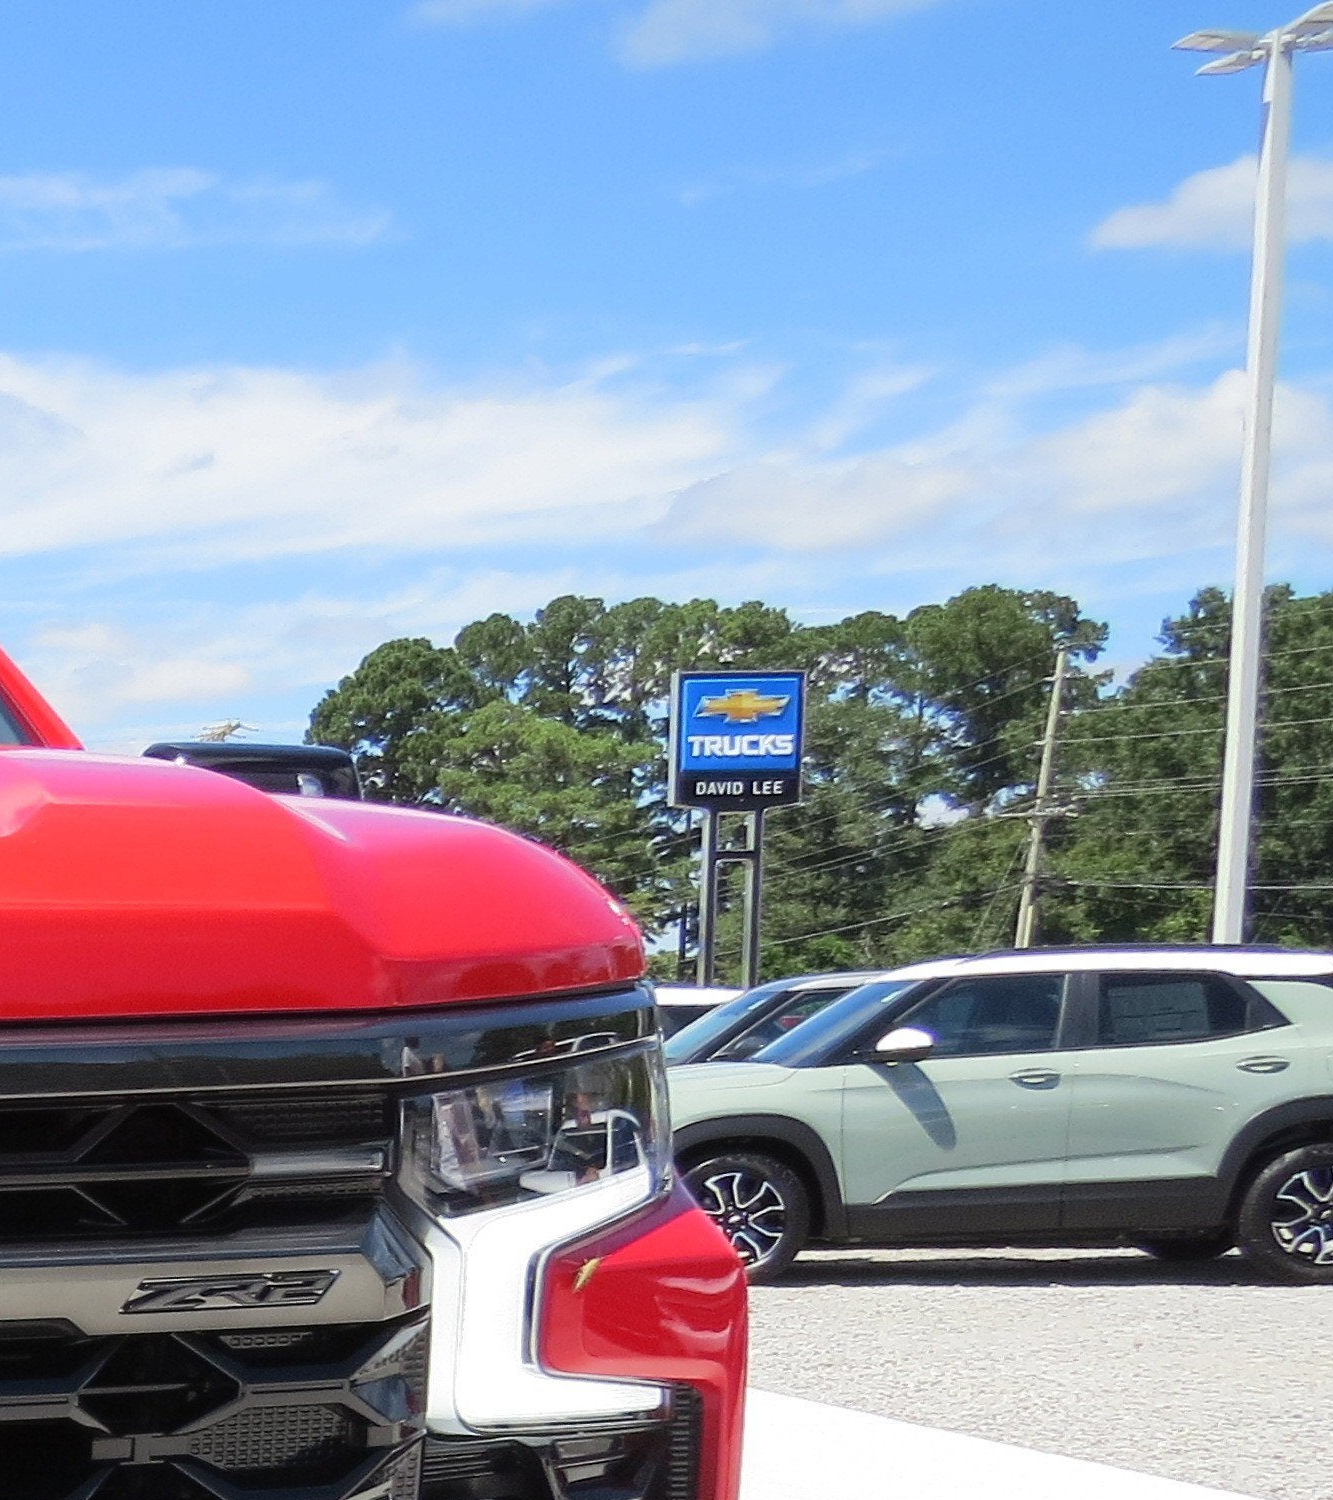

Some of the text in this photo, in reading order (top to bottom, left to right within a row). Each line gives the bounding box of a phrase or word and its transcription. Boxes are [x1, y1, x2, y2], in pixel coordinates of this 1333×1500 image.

[687, 734, 795, 757] TRUCKS
[695, 780, 784, 796] DAVID LEE
[118, 1268, 342, 1315] ZR2
